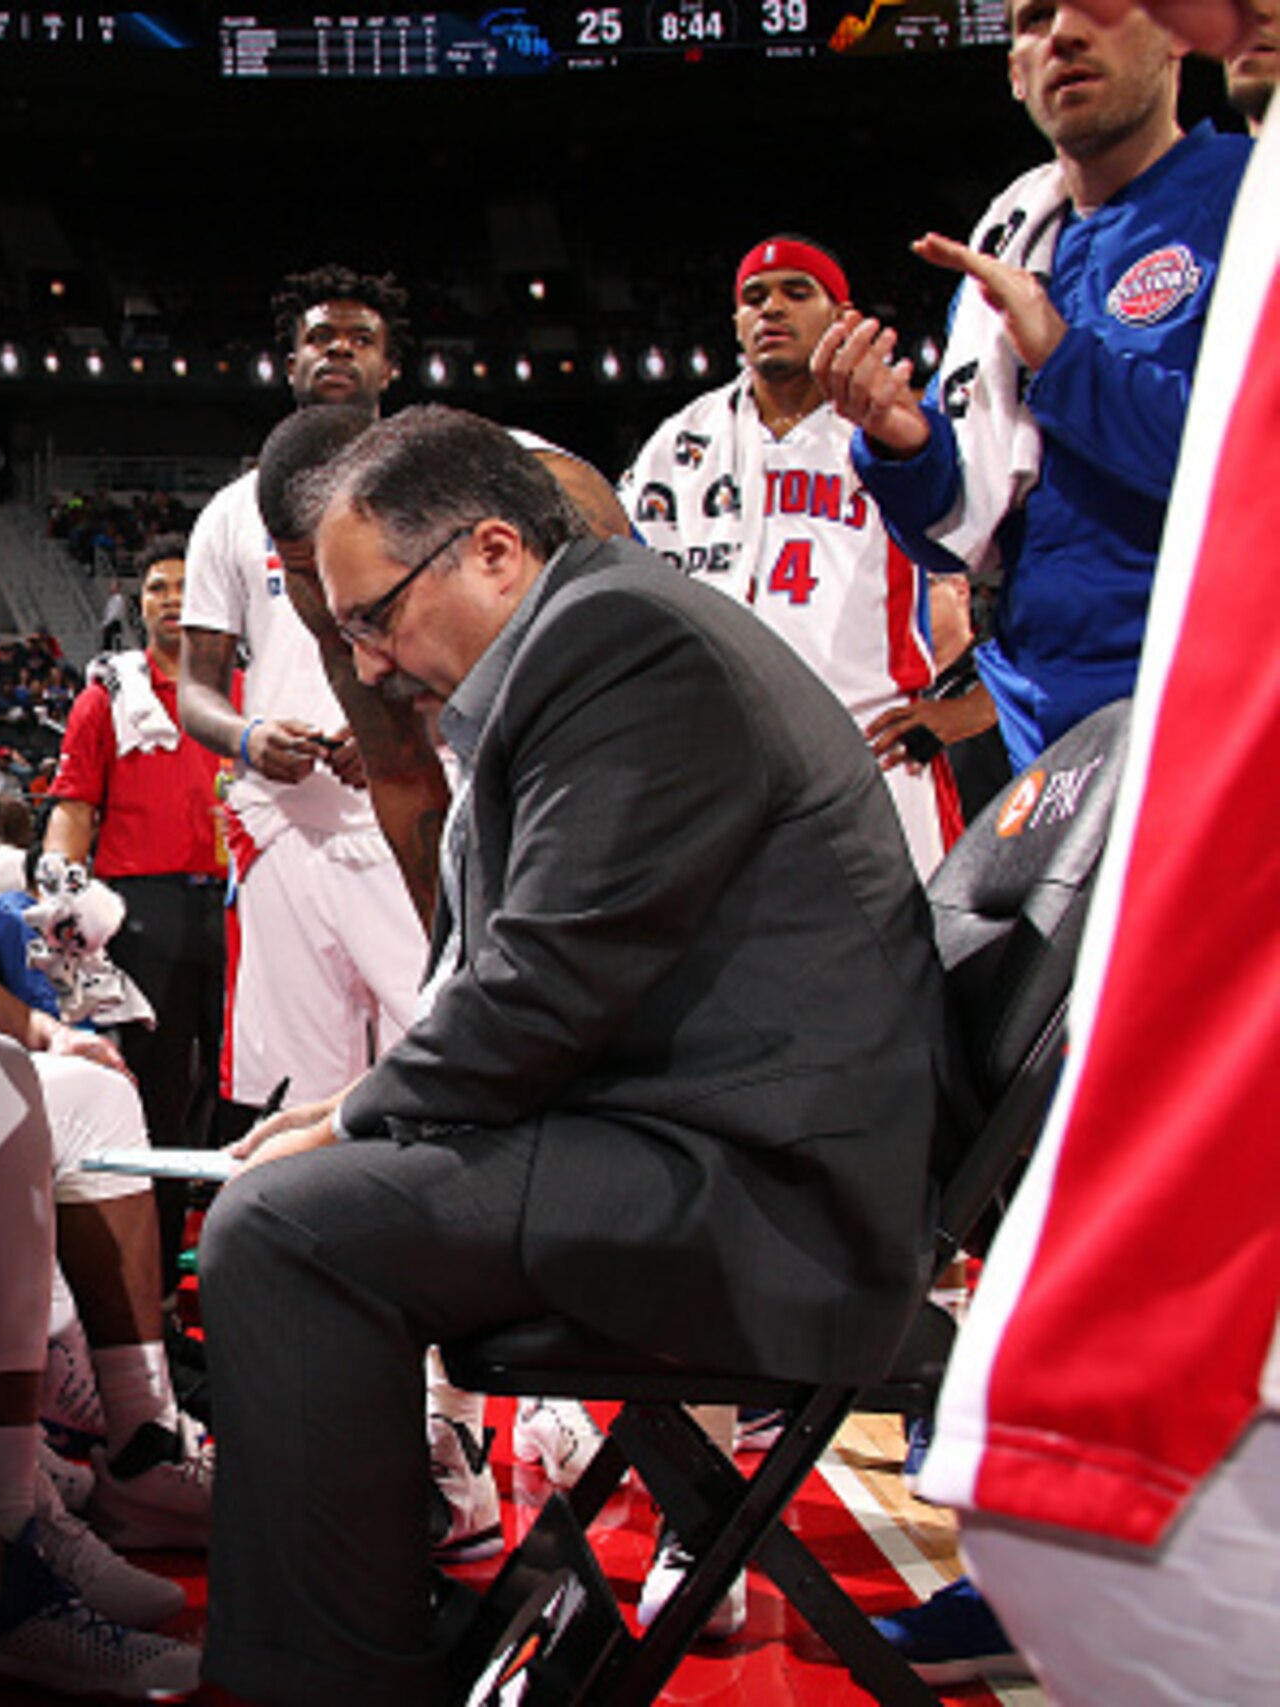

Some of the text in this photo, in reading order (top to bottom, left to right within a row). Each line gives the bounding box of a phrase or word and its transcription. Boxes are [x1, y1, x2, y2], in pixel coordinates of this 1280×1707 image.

[577, 8, 621, 44] 25
[661, 11, 723, 42] 8:44
[762, 0, 808, 33] 39
